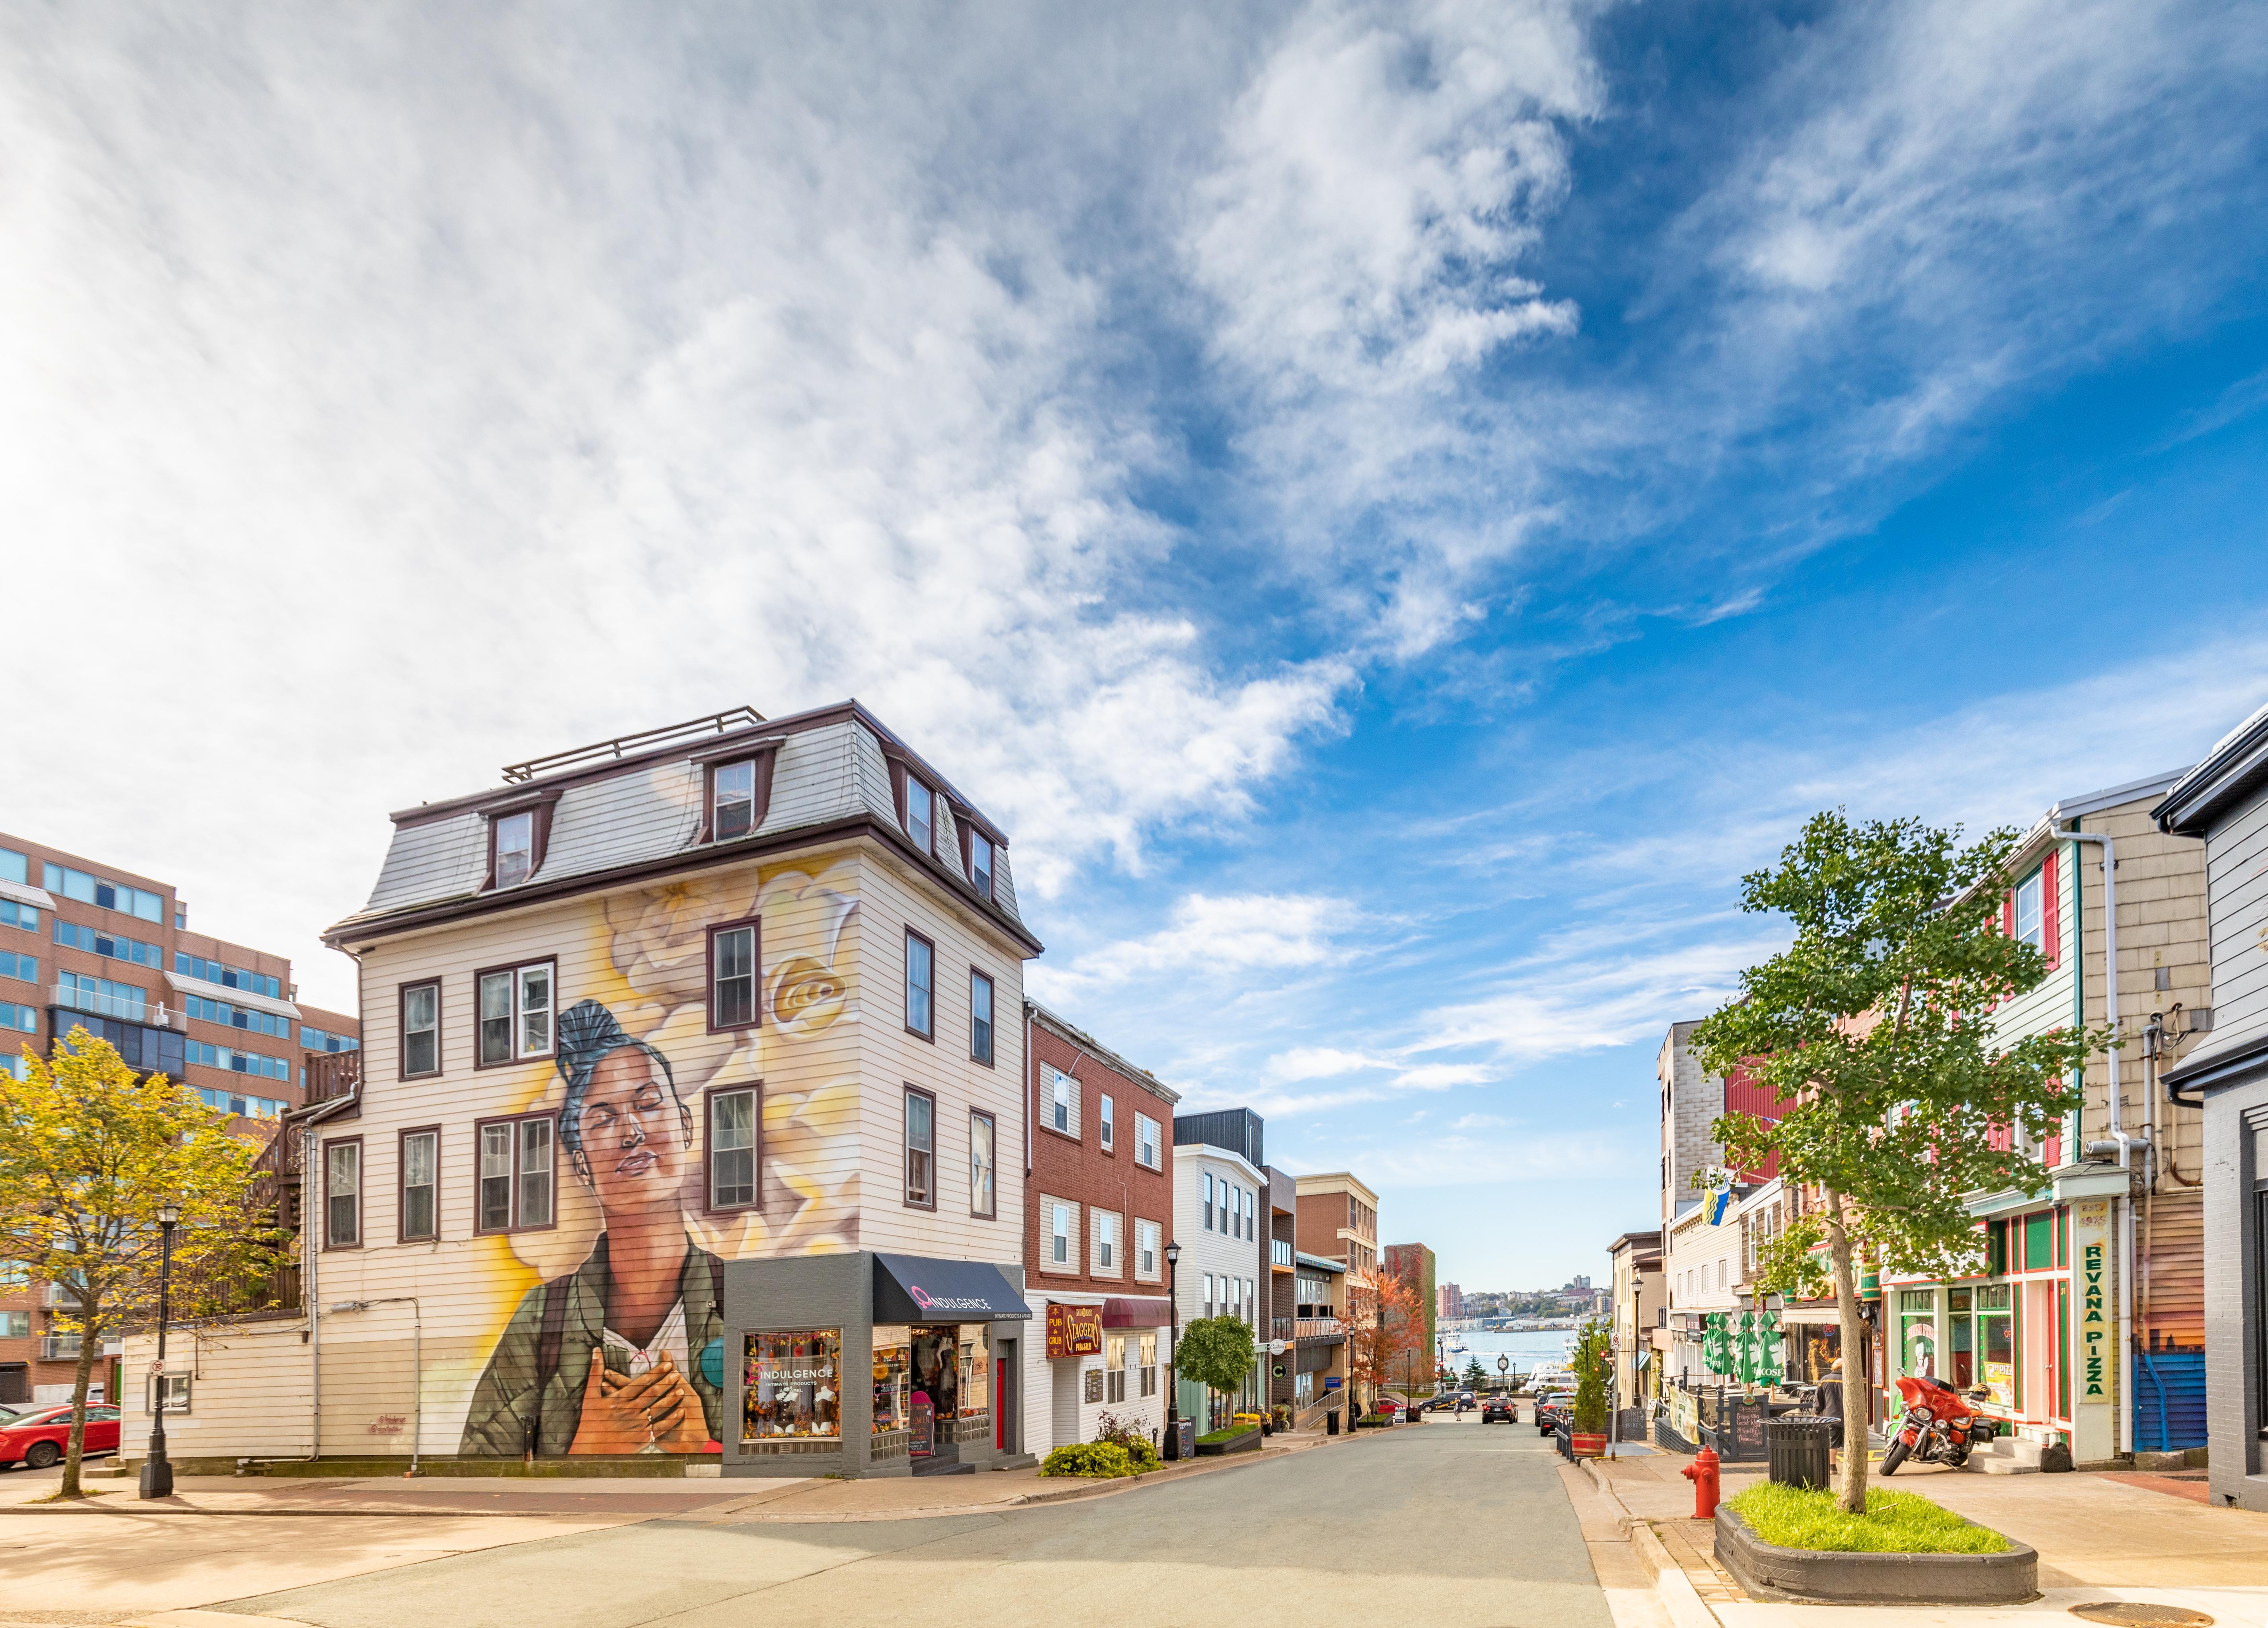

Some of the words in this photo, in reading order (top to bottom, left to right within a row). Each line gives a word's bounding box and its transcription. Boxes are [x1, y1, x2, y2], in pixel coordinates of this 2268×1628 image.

[2085, 1246, 2102, 1322] REVANA
[930, 1297, 992, 1309] INDULGENCE
[1049, 1318, 1062, 1327] PUB
[1066, 1314, 1100, 1351] STAGGERS
[1048, 1337, 1062, 1345] GRUB
[2085, 1331, 2103, 1395] PIZZA
[760, 1369, 832, 1379] INDULGENCE
[1739, 1403, 1761, 1413] Specials
[1737, 1413, 1750, 1421] Crispy
